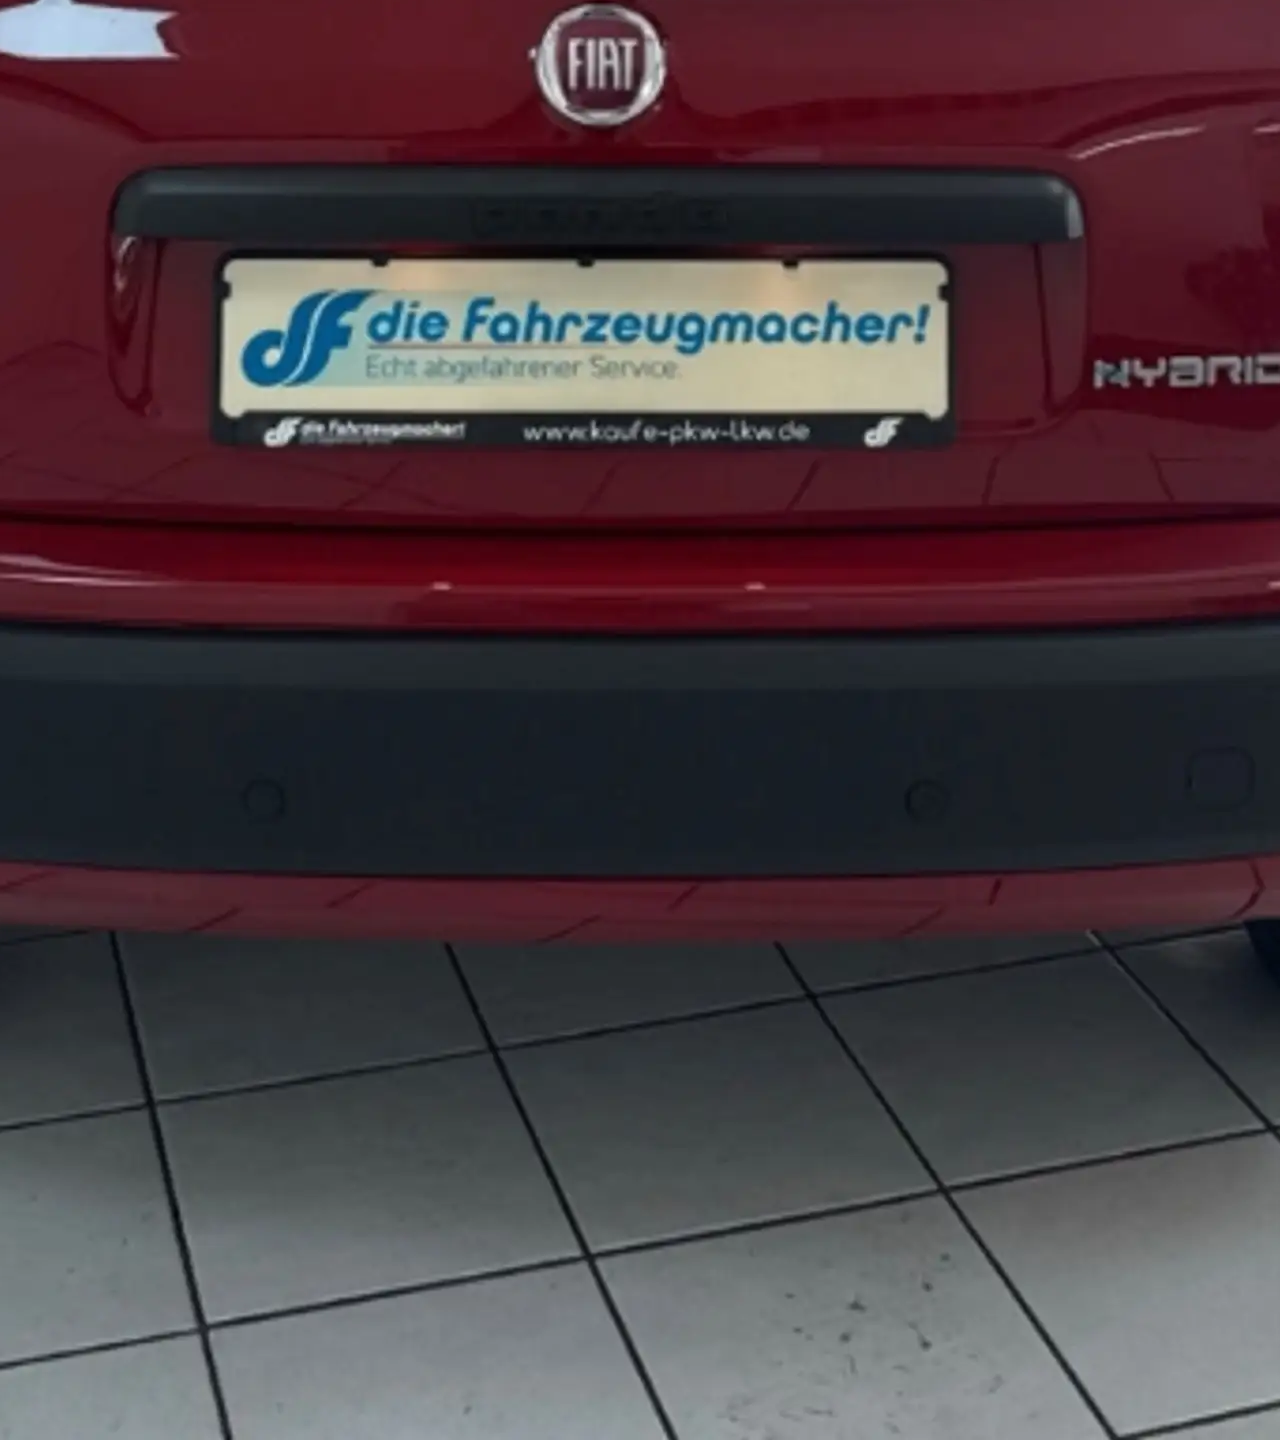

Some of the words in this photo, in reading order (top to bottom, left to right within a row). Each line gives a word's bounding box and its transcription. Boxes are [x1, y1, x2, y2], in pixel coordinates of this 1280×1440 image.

[567, 36, 639, 91] FIAT
[367, 300, 449, 343] die
[462, 296, 931, 355] Fahrzeugmacher!
[365, 355, 418, 379] Echt
[422, 355, 583, 384] abgefahrener
[590, 356, 682, 380] Service.
[523, 418, 811, 447] www.kaufe-pkw-lkw.de
